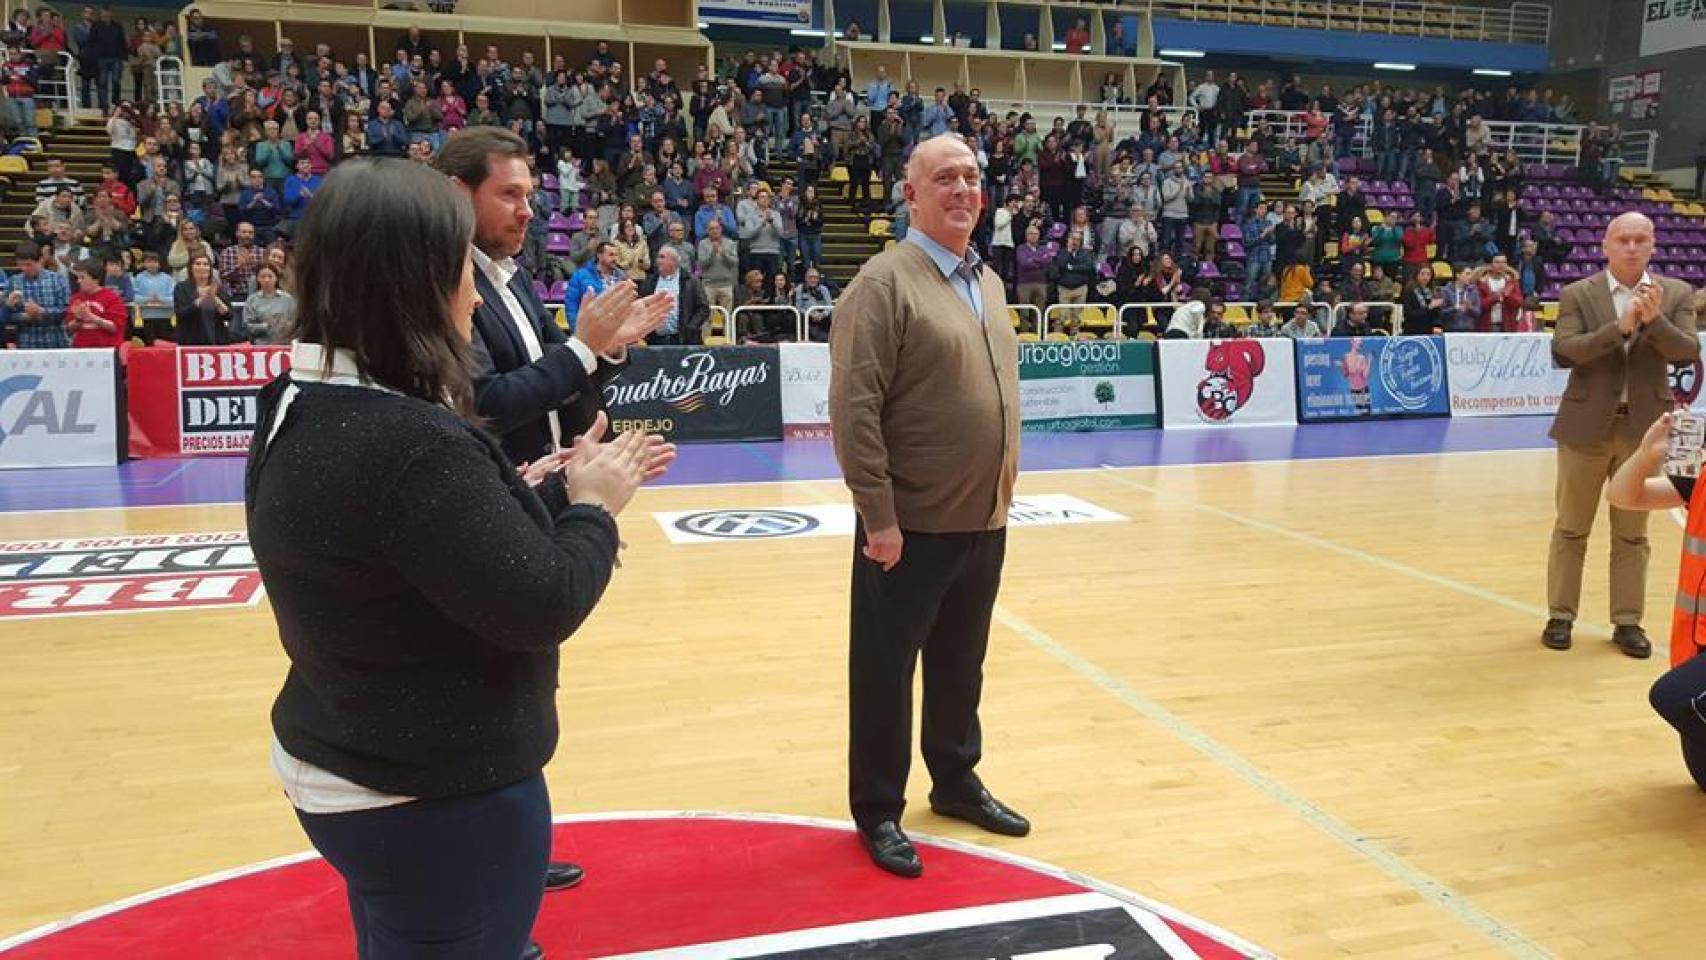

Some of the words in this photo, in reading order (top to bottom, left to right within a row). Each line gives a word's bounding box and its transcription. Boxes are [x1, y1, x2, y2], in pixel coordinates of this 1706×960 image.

[1646, 2, 1670, 22] EL
[1447, 346, 1485, 366] Club
[1453, 394, 1525, 412] Recompensa
[1528, 394, 1540, 407] tu
[177, 533, 249, 544] CIOS
